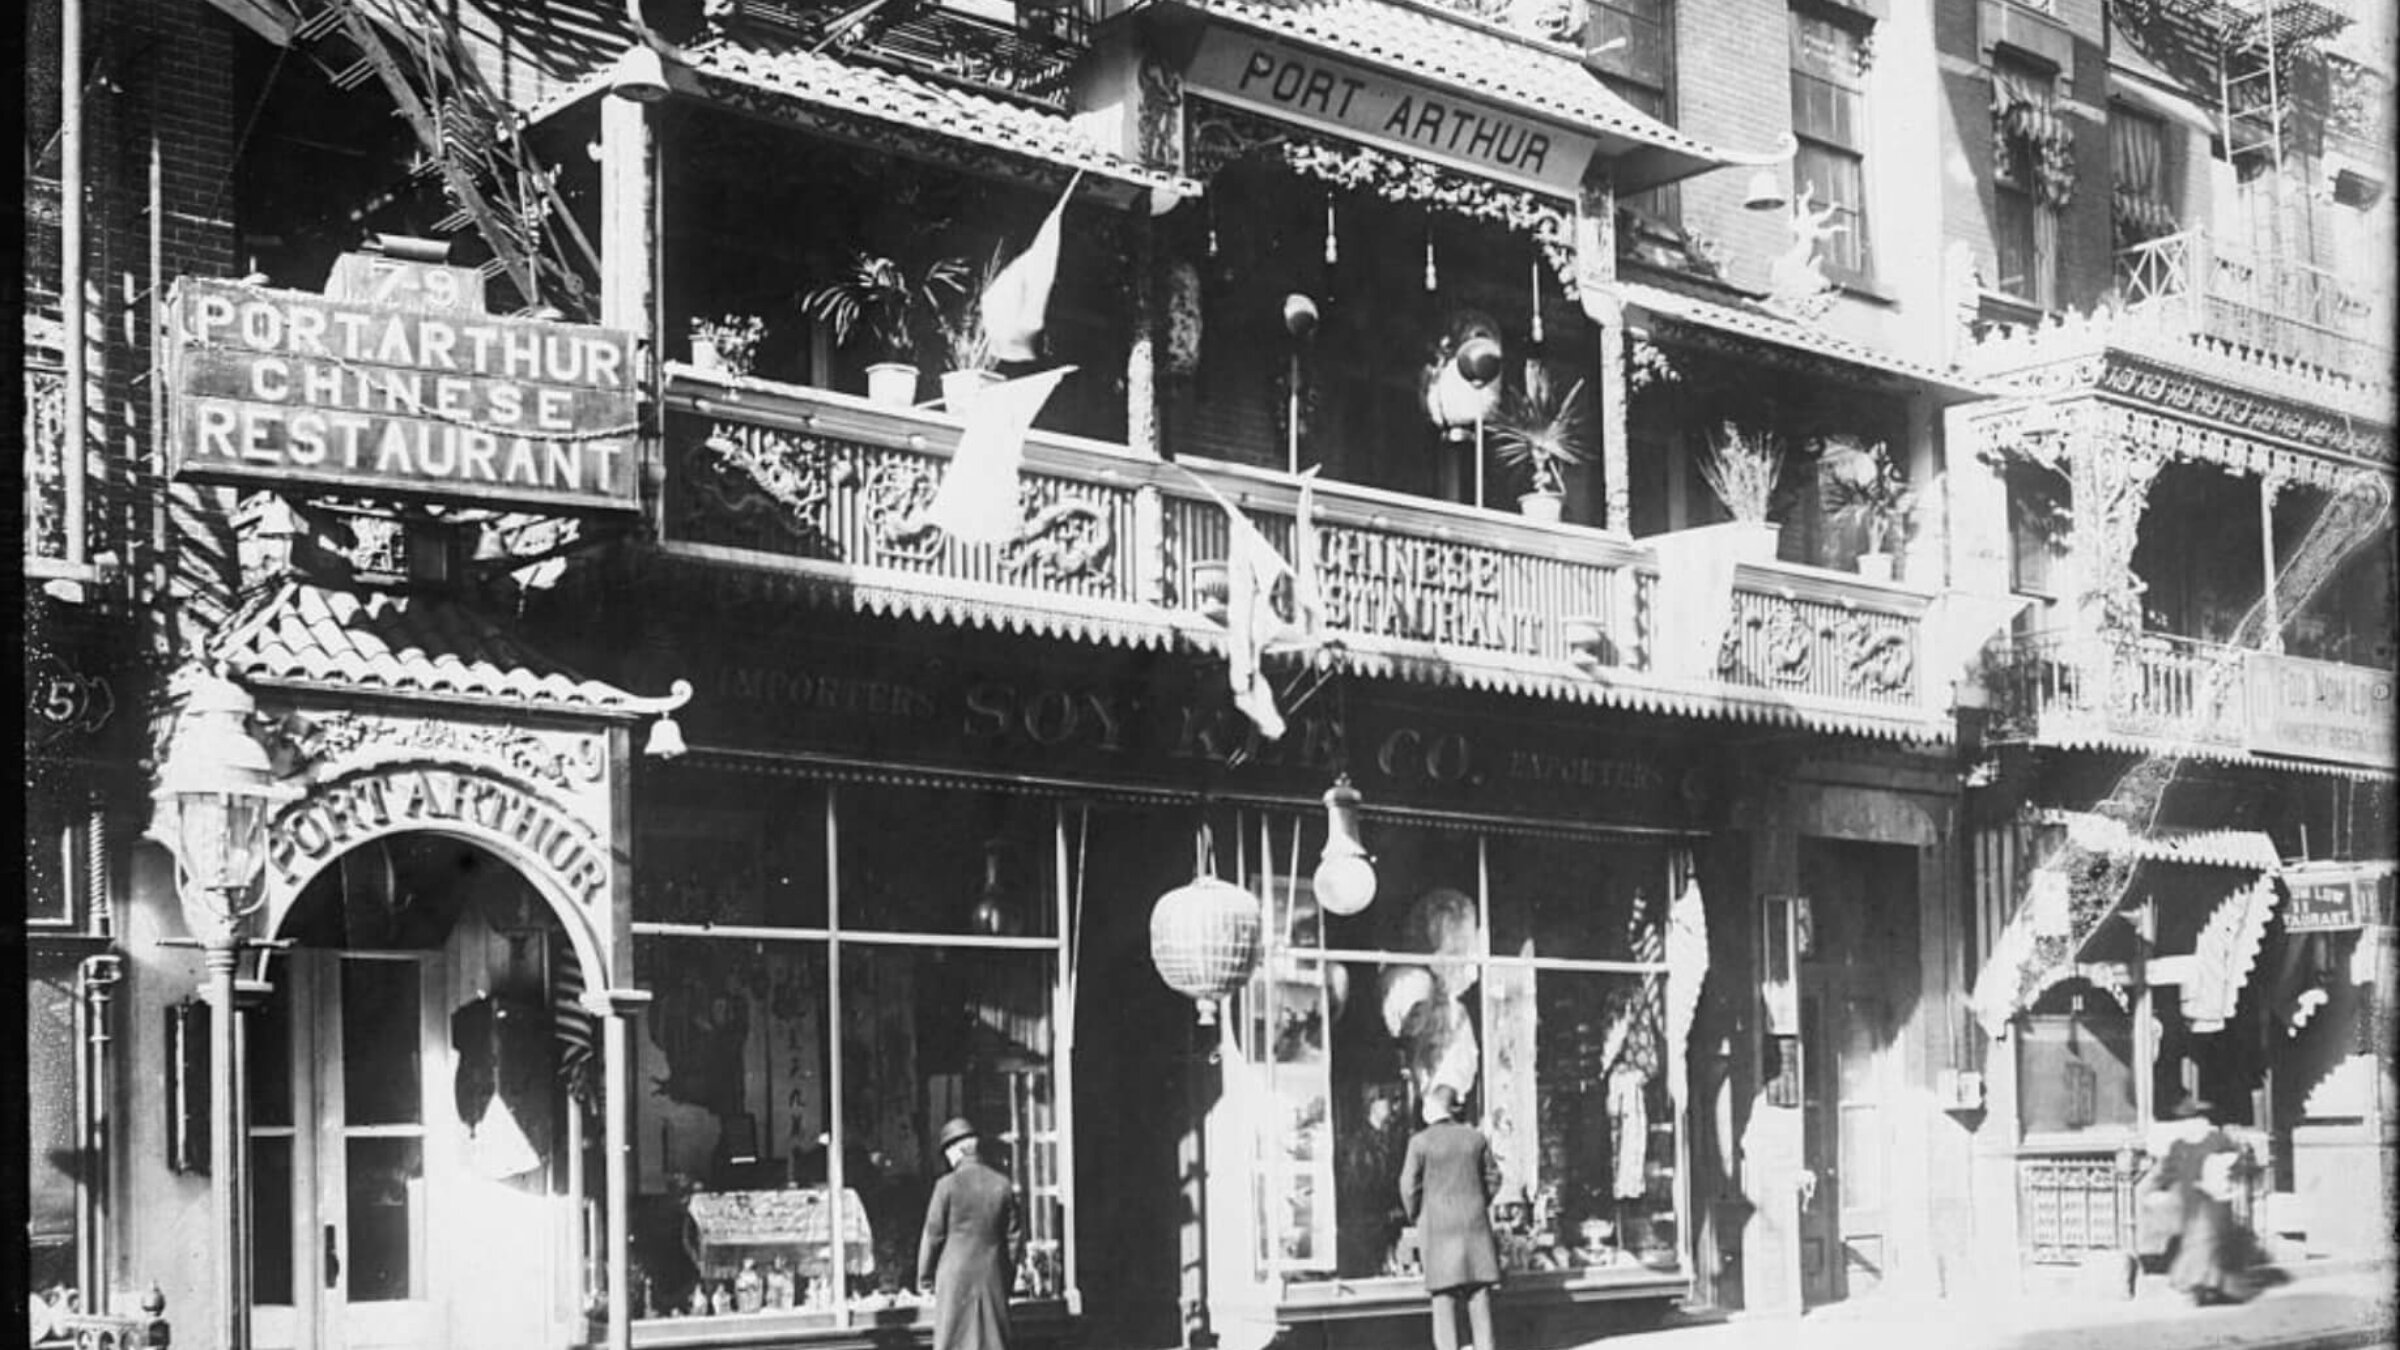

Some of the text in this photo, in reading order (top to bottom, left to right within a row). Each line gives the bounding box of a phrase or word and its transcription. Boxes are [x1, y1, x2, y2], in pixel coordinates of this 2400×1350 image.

[1238, 52, 1551, 174] PORT ARTHUR
[251, 357, 574, 430] CHINESE
[199, 402, 622, 492] RESTAURANT
[1312, 527, 1499, 598] CHINESE
[1322, 572, 1543, 657] STAURANT
[716, 663, 934, 720] IMPORTERS
[962, 680, 1138, 753] SOY
[1377, 728, 1484, 786] CO.
[267, 769, 606, 905] PORT ARTHUR
